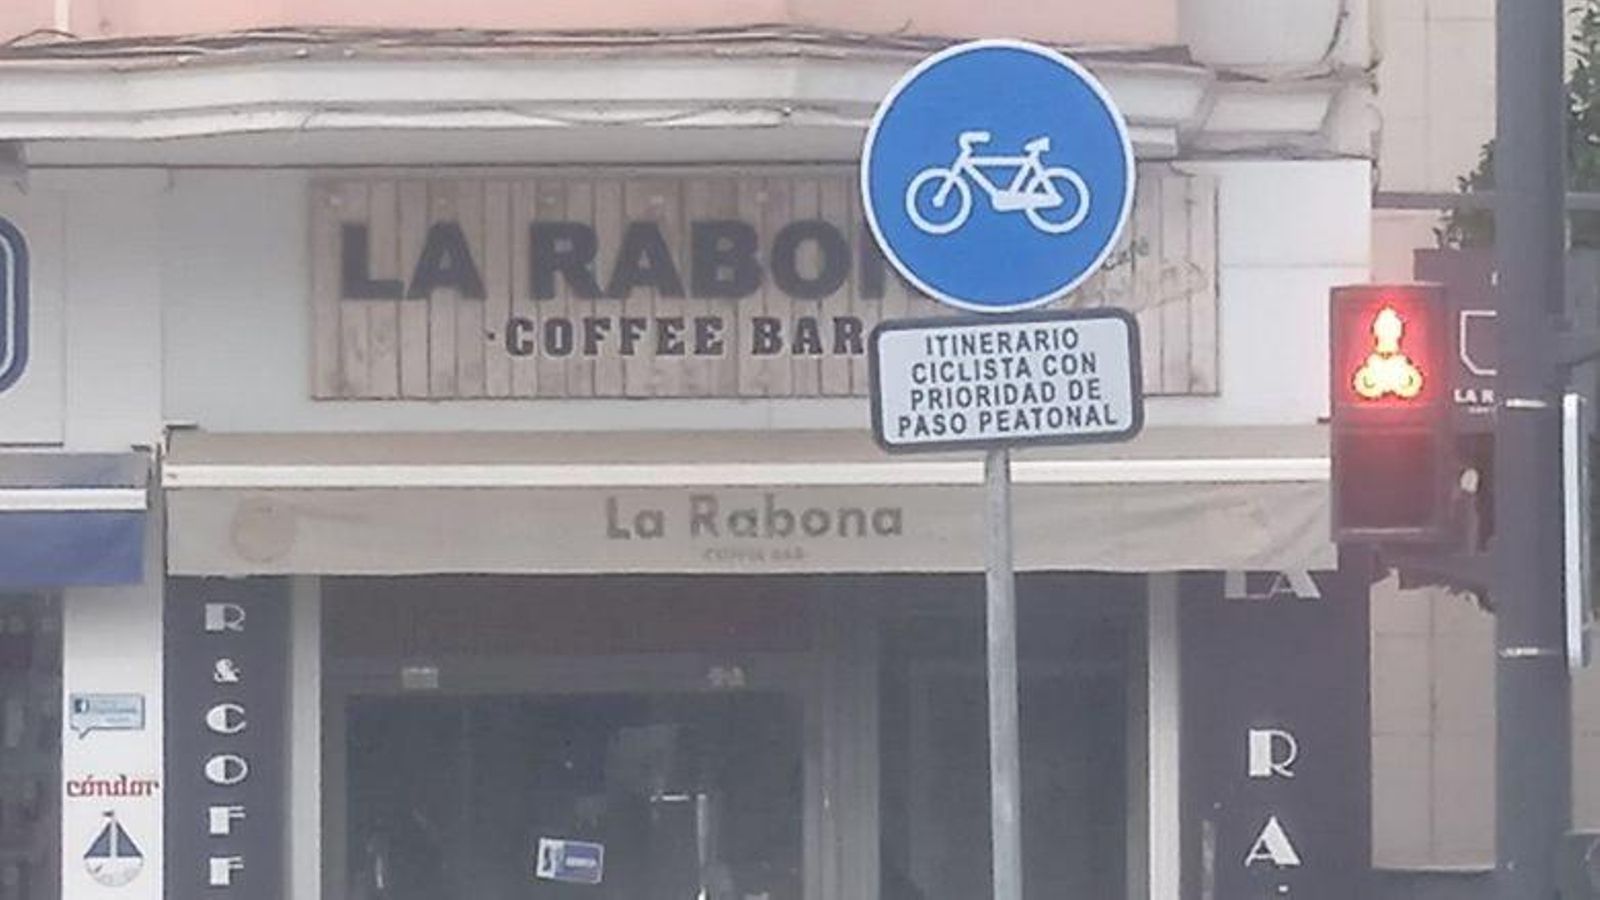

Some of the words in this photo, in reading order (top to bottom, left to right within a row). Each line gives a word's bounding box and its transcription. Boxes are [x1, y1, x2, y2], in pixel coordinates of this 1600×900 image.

[340, 219, 488, 301] LA
[504, 316, 725, 357] COFFEE
[751, 314, 866, 356] BAR
[926, 327, 1079, 357] ITINERARIO
[911, 356, 1032, 385] CICLISTA
[1042, 352, 1097, 376] CON
[910, 381, 1056, 411] PRIORIDAD
[1068, 378, 1101, 401] DE
[898, 413, 967, 437] PASO
[979, 404, 1118, 433] PEATONAL
[605, 496, 664, 539] La
[689, 493, 903, 539] Rabona
[66, 774, 160, 797] cóndor
